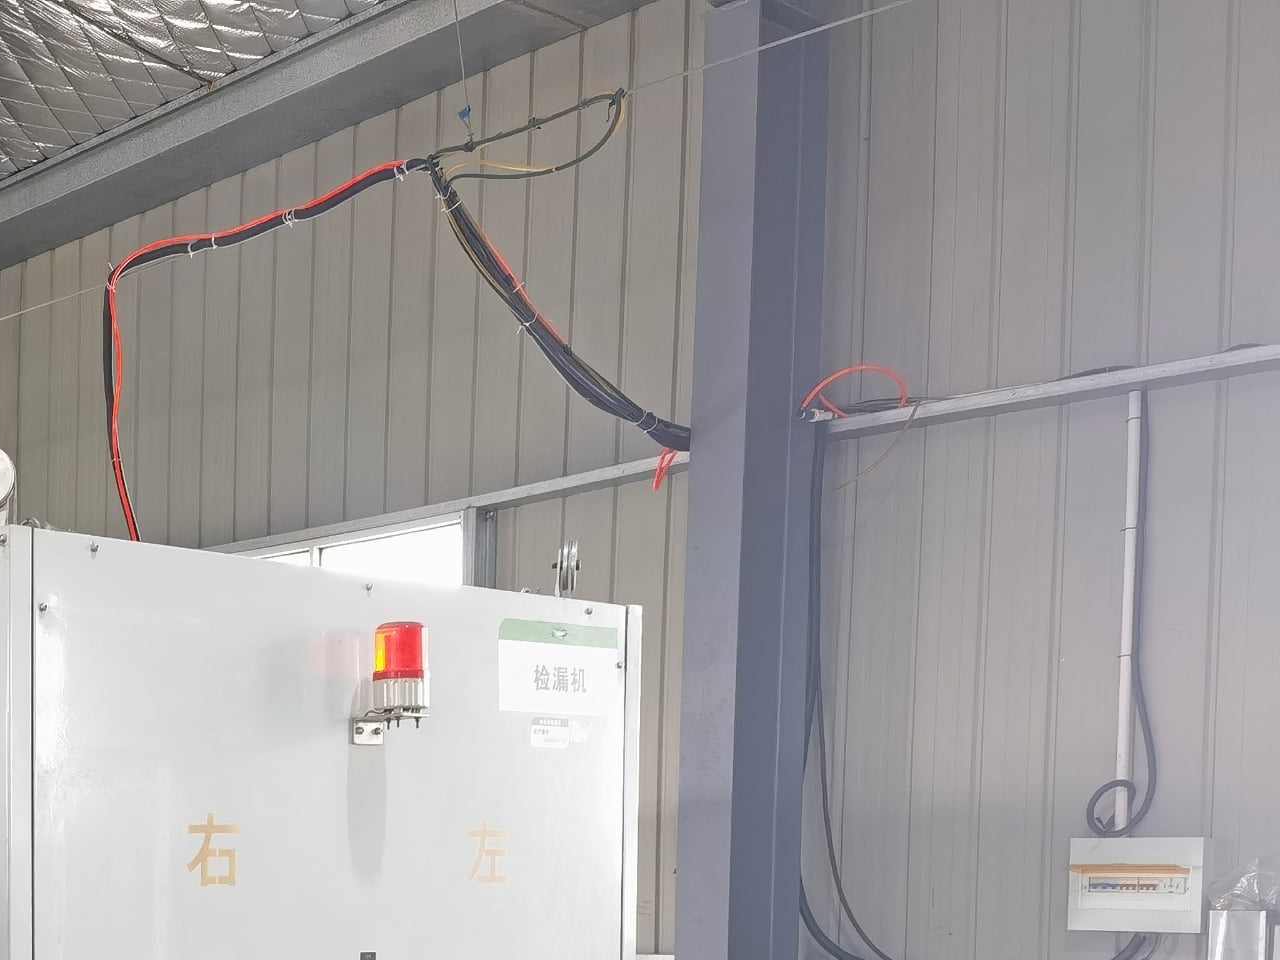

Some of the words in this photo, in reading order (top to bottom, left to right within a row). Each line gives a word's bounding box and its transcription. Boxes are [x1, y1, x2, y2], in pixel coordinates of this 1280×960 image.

[533, 664, 587, 693] 检漏机
[186, 812, 240, 887] 右
[467, 819, 508, 883] 左
